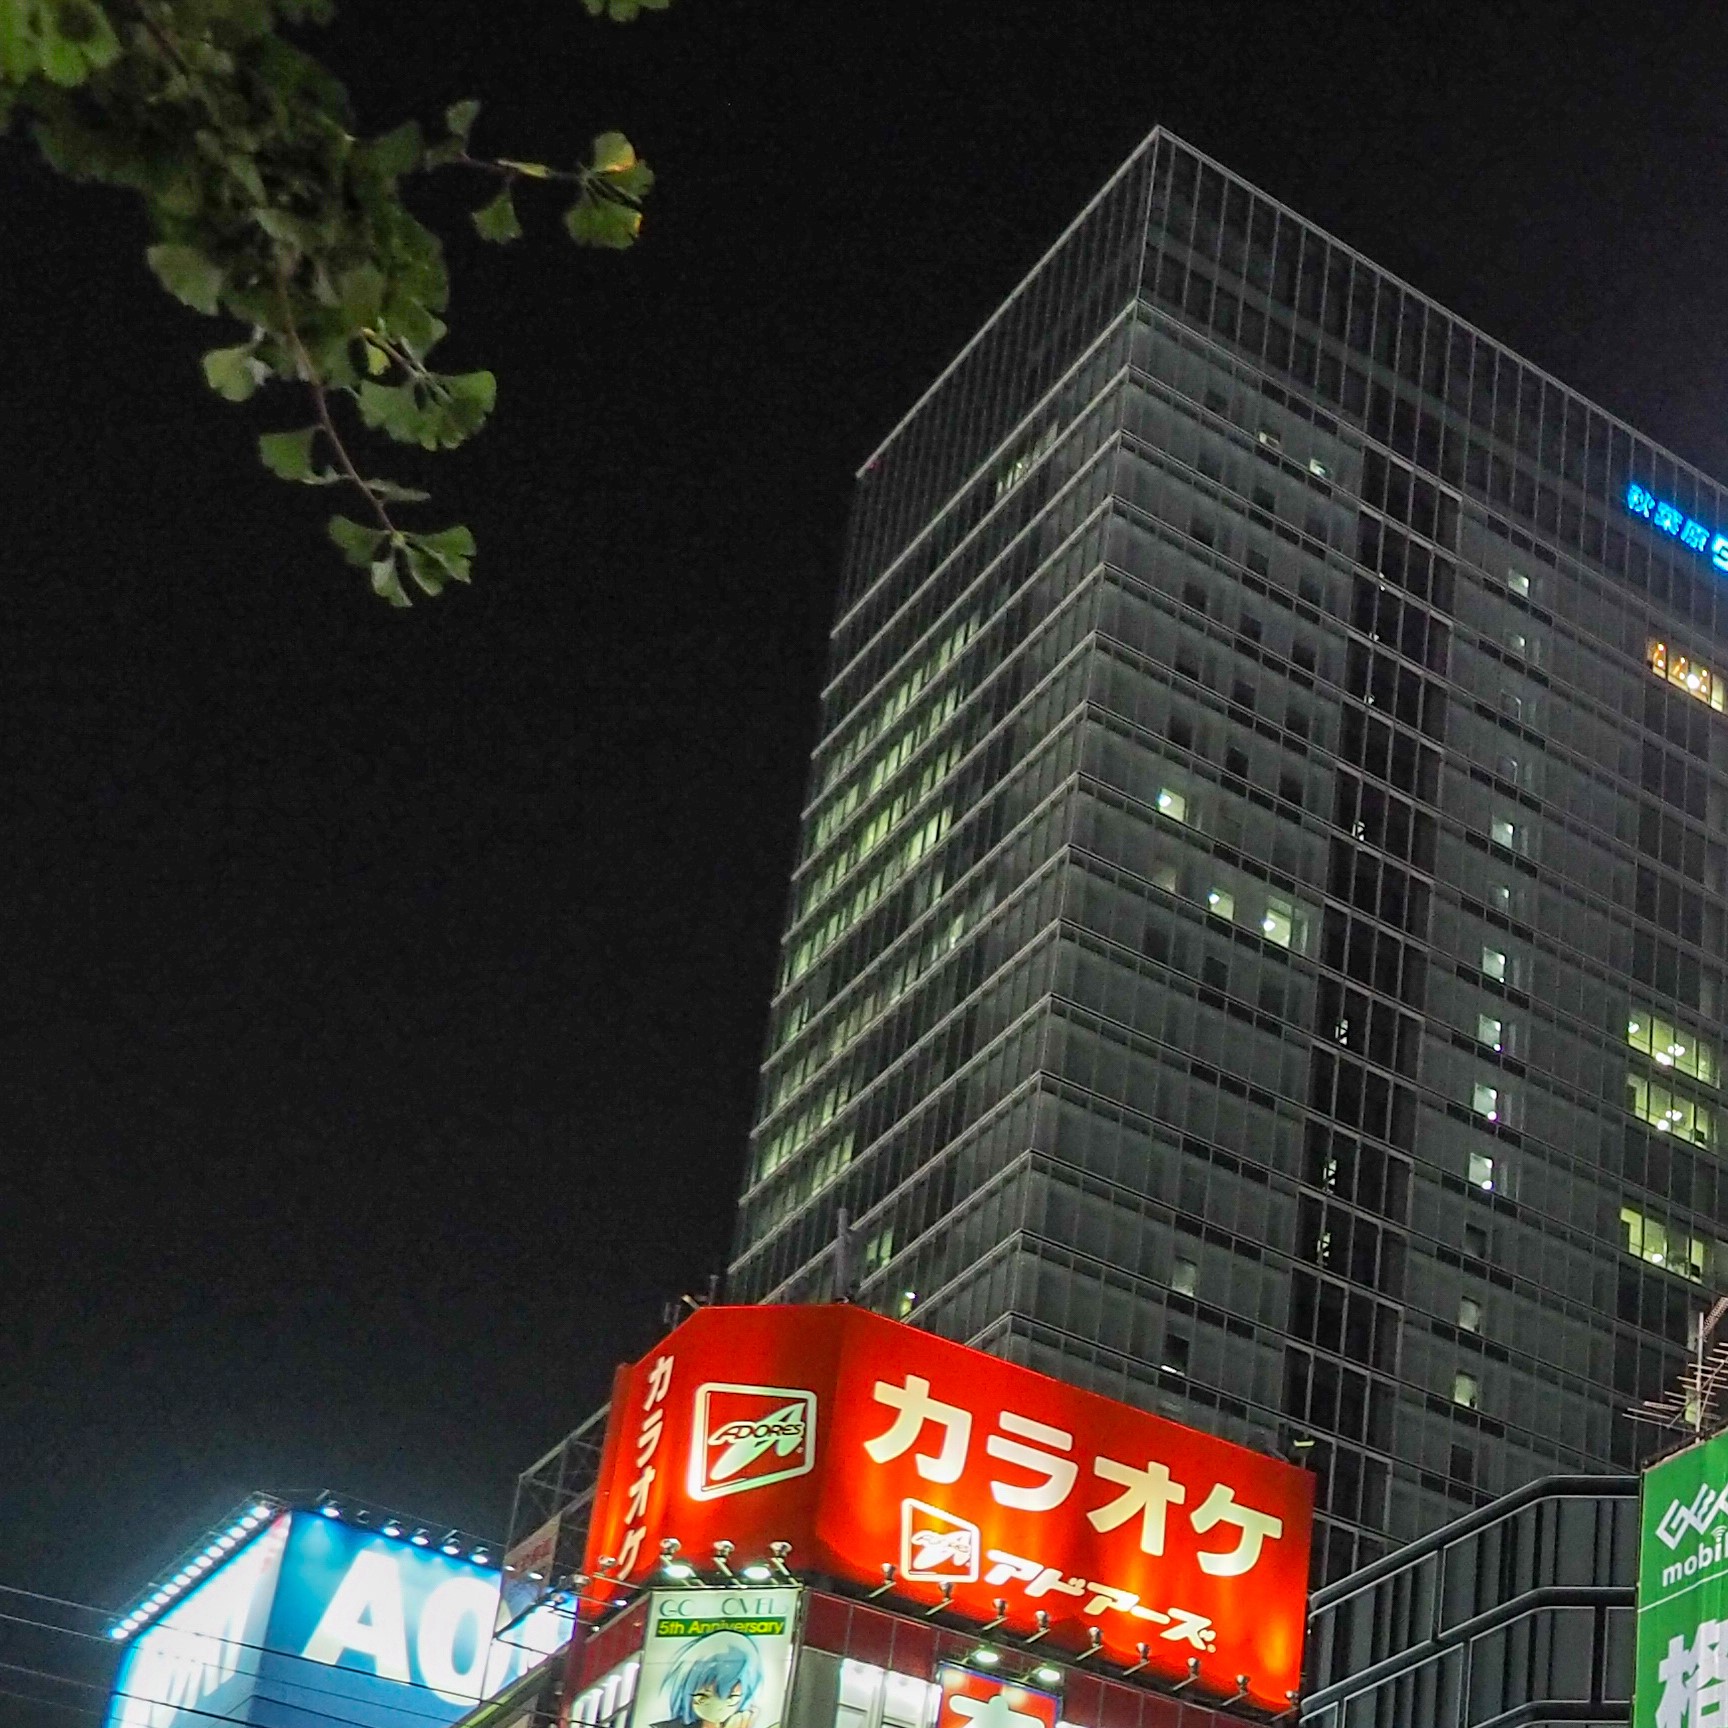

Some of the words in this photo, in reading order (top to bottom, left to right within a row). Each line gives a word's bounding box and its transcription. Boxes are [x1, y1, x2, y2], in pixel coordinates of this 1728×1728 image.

[615, 1353, 675, 1583] カラオケ
[708, 1419, 805, 1447] ADORES
[864, 1373, 1284, 1577] カラオケ
[658, 1618, 687, 1637] 5th
[689, 1614, 785, 1638] Anniversary
[984, 1549, 1217, 1651] アドアーズ
